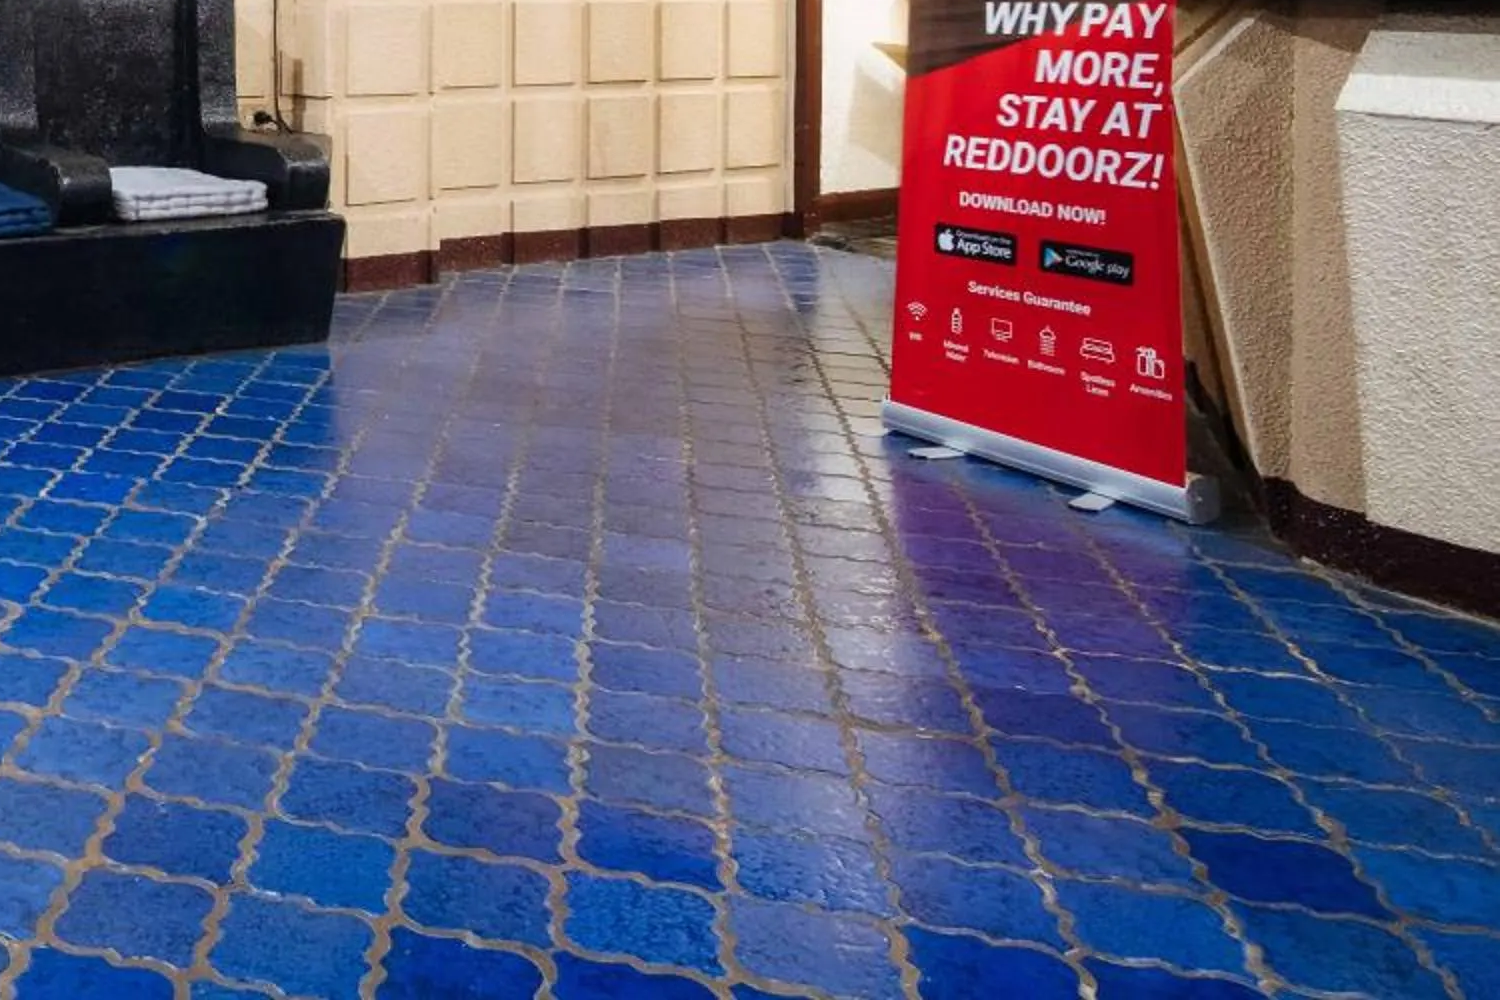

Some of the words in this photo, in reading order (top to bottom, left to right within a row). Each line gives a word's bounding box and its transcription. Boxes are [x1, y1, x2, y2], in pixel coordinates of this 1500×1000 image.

[985, 1, 1078, 36] WHY
[1079, 2, 1167, 39] PAY
[1034, 49, 1164, 97] MORE,
[996, 93, 1096, 132] STAY
[1101, 101, 1162, 138] AT
[943, 134, 1164, 190] REDDOORZ!
[959, 191, 1053, 218] DOWNLOAD
[1057, 204, 1106, 225] NOW!
[957, 238, 980, 255] App
[981, 241, 1013, 259] Store
[1065, 255, 1103, 276] Google
[967, 280, 1021, 301] Services
[1023, 291, 1092, 317] Guarantee
